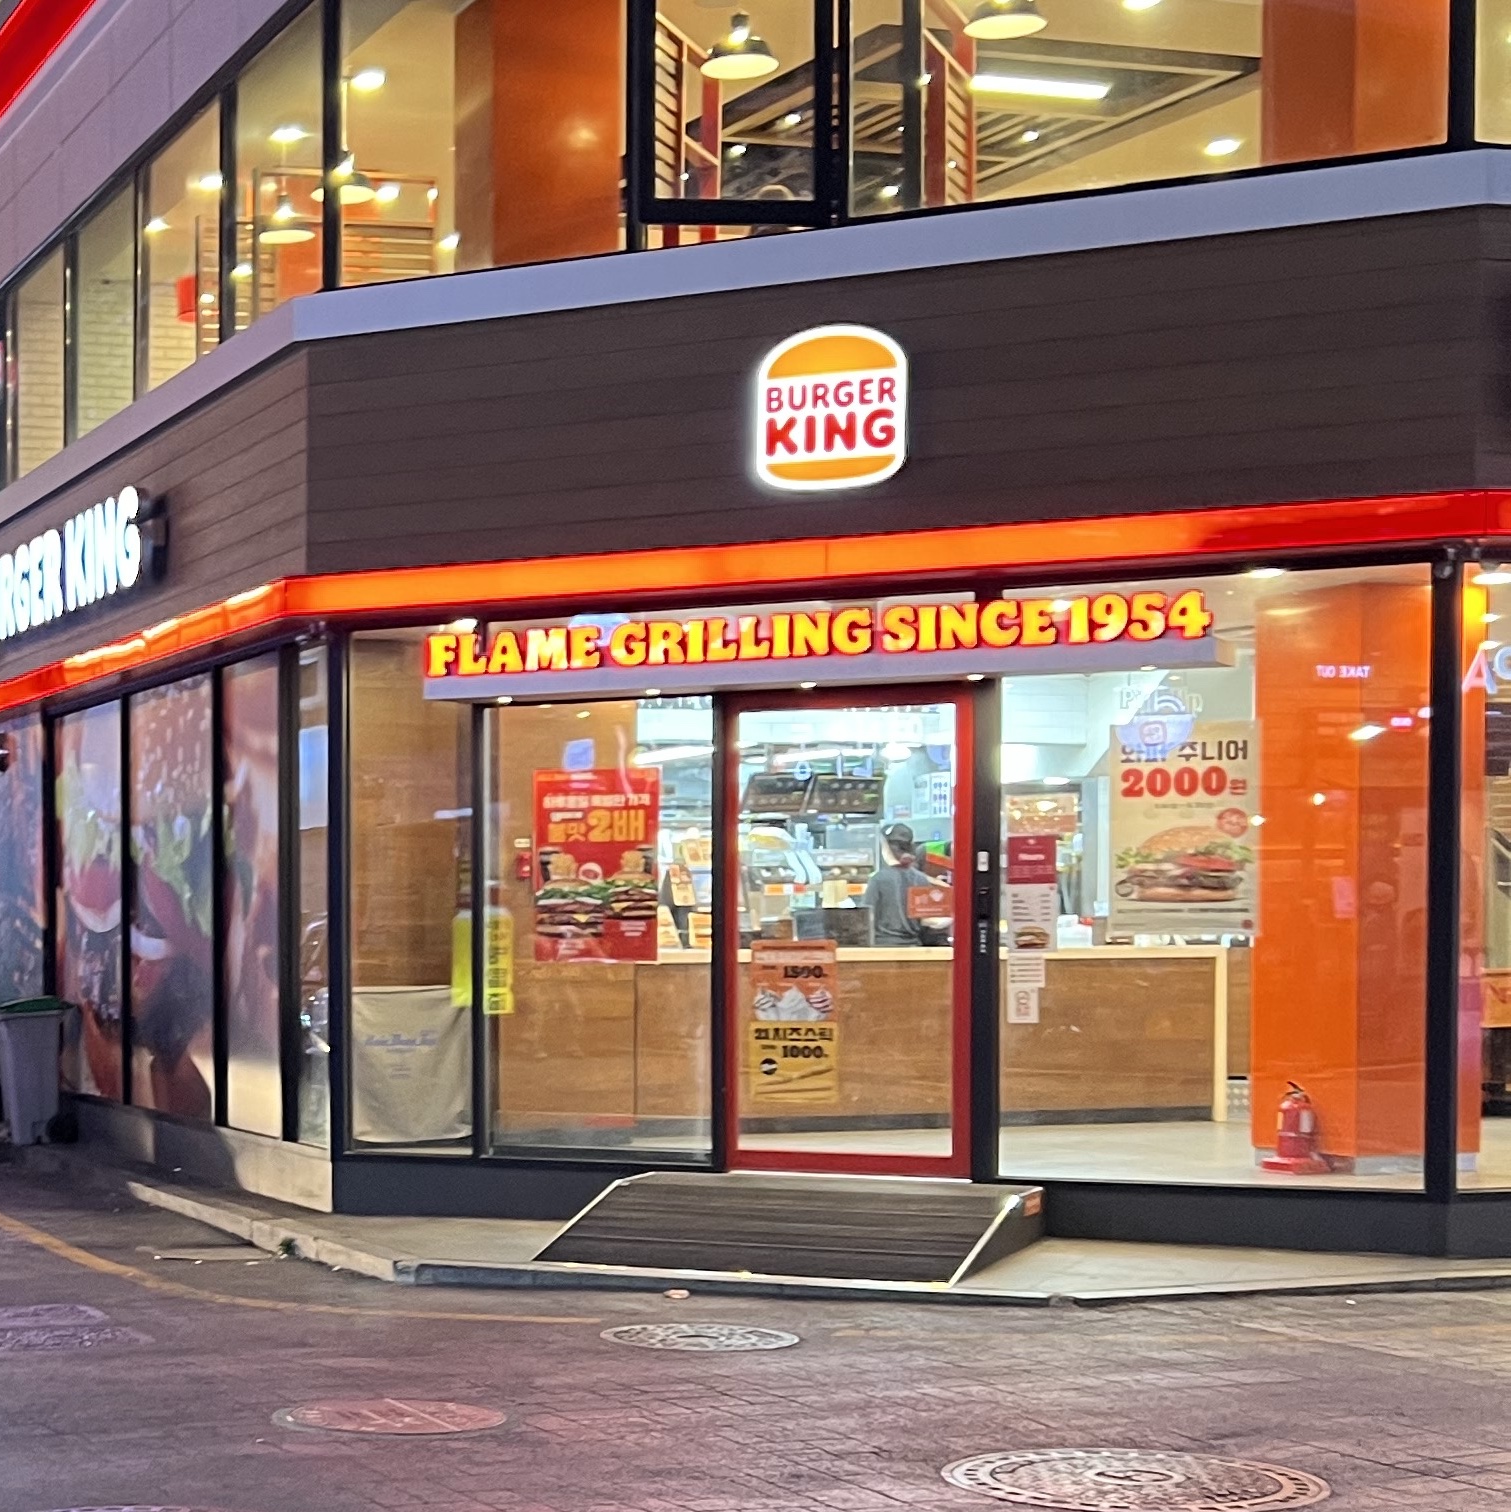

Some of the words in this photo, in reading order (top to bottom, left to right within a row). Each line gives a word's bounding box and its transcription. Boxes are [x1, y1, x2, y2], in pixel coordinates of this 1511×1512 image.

[765, 377, 897, 413] BURGER
[765, 408, 897, 457] KING
[64, 485, 142, 612] KING
[426, 625, 604, 679] FLAME
[609, 607, 874, 667] GRILLING
[882, 597, 1058, 653] SINCE
[1066, 589, 1214, 644] 1954
[1177, 739, 1249, 763] 주니어
